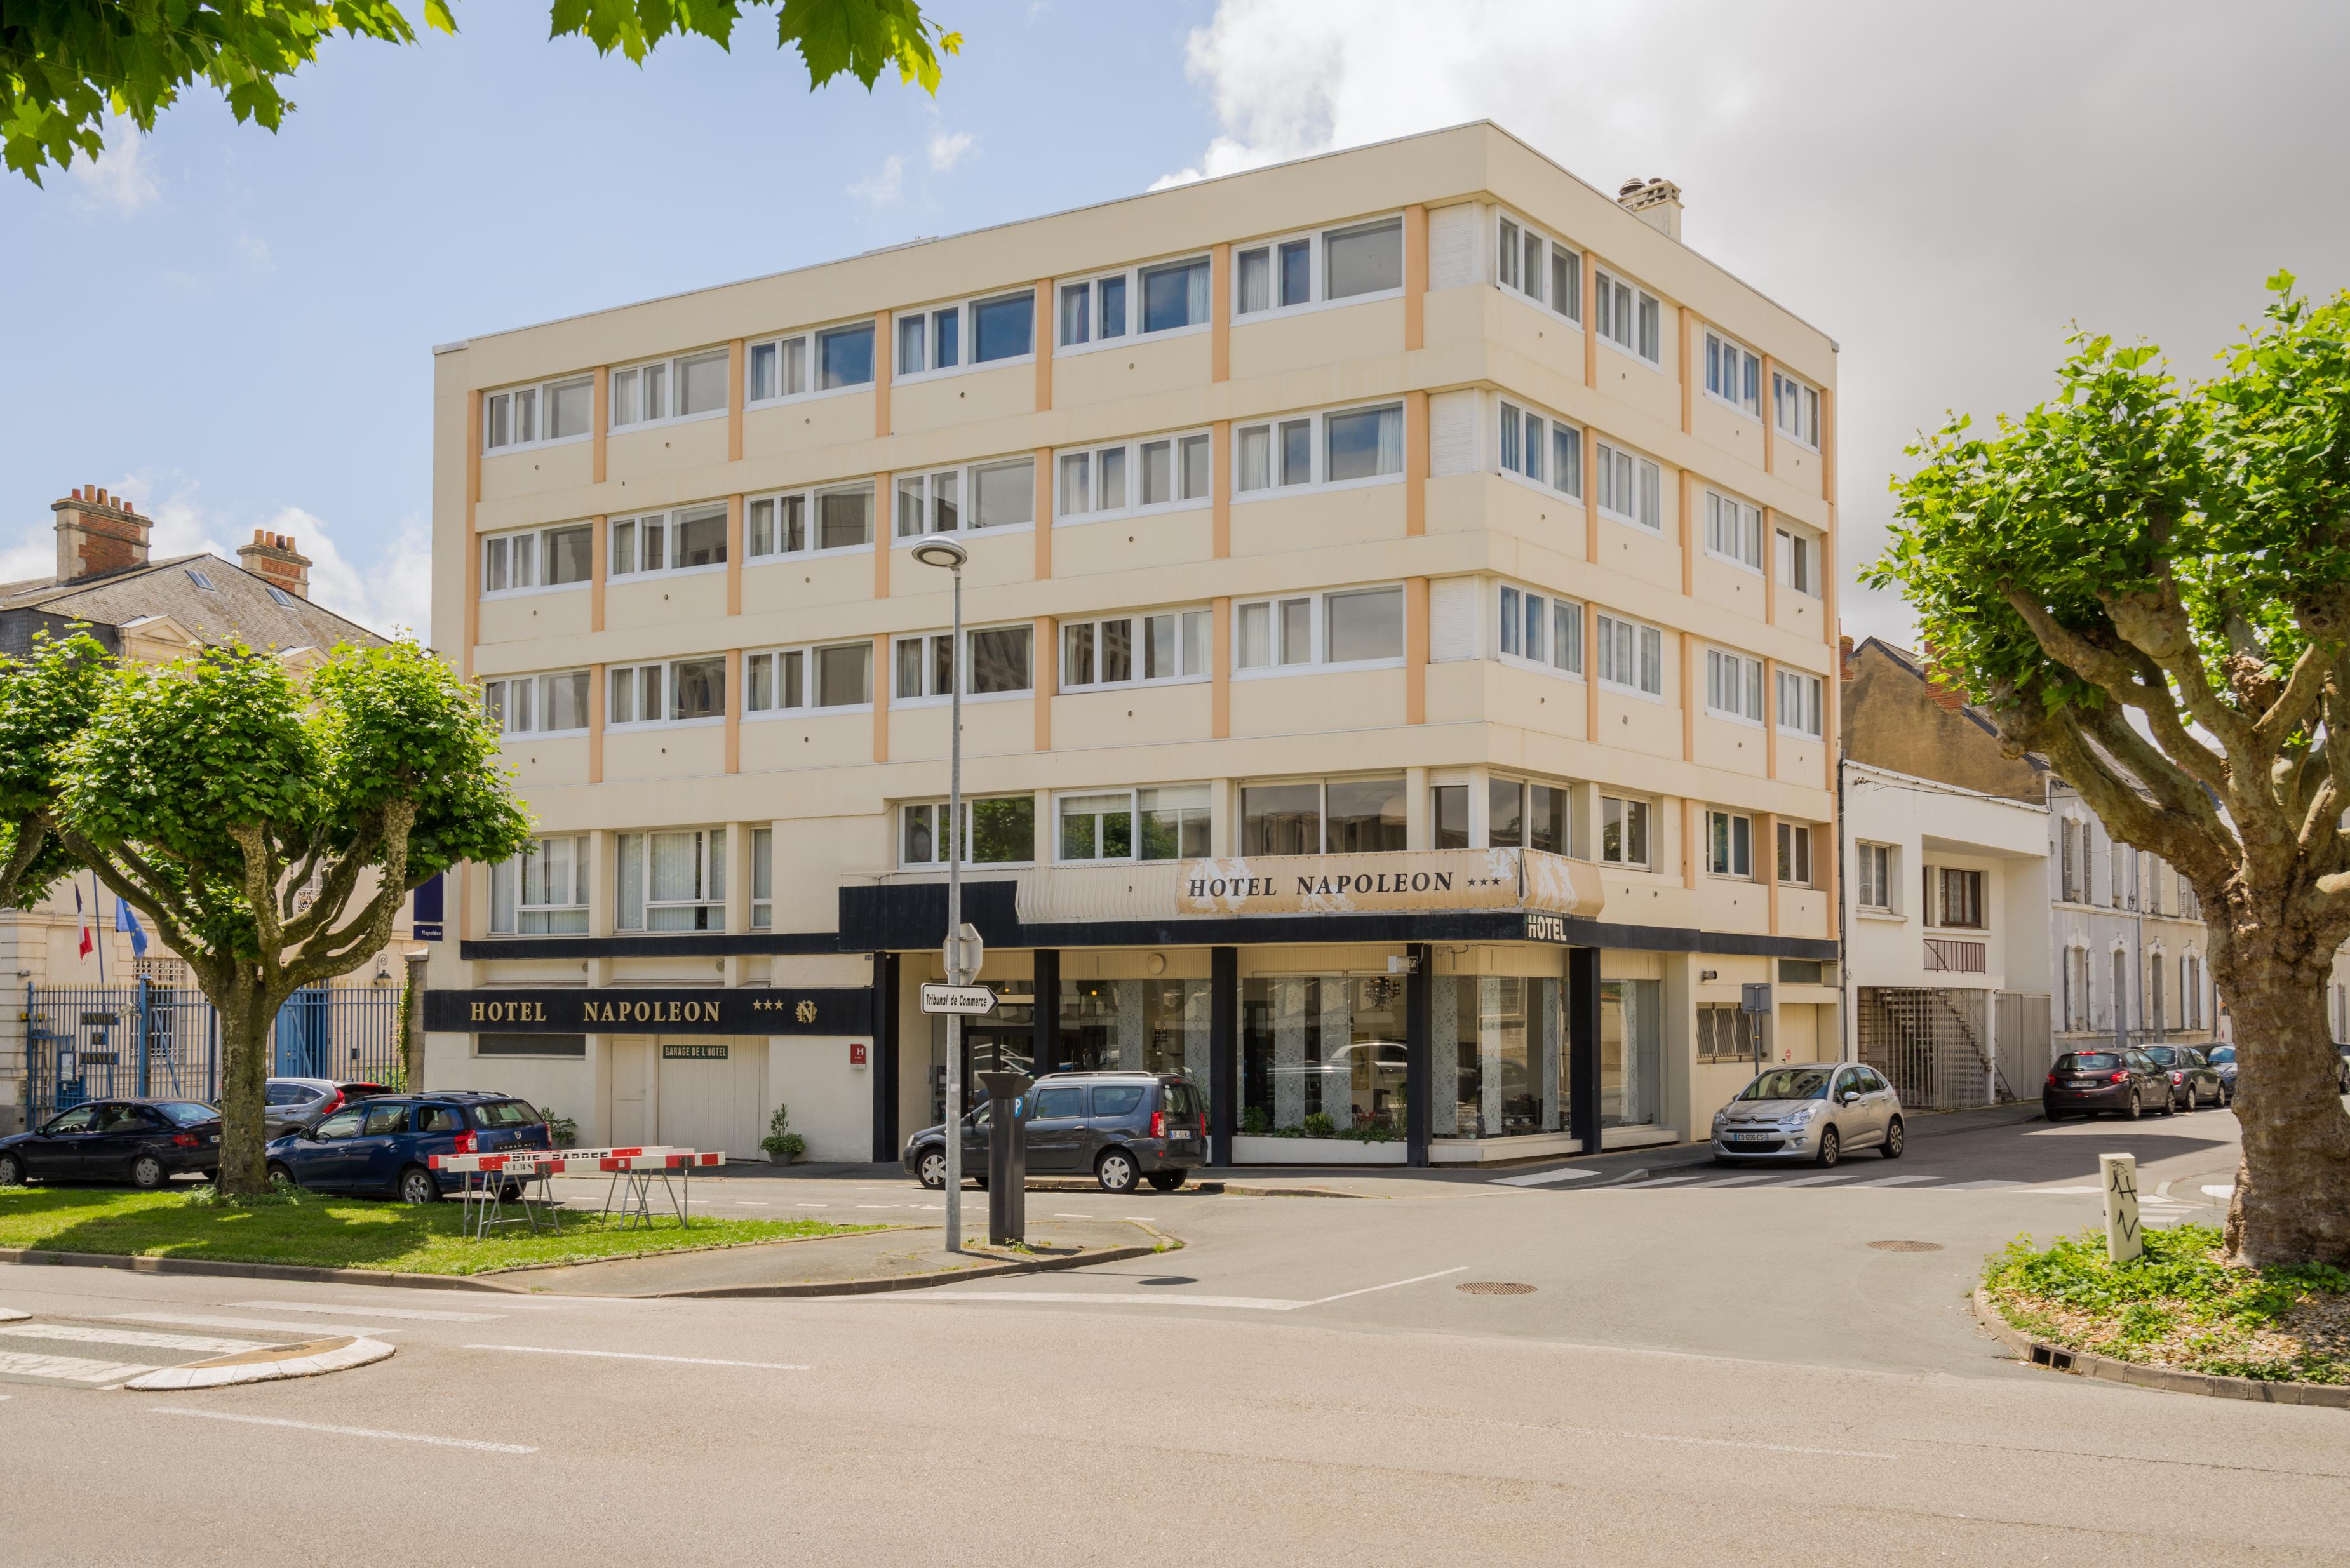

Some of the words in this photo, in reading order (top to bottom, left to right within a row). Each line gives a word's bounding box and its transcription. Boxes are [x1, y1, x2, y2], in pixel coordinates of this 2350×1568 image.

[1188, 877, 1277, 897] HOTEL
[1296, 871, 1454, 895] NAPOLEON
[1528, 914, 1567, 941] HOTEL
[926, 994, 948, 1005] Tribunal
[950, 995, 957, 1006] de
[959, 995, 987, 1007] Commerce
[470, 1002, 547, 1021] HOTEL
[583, 1002, 721, 1022] NAPOLEON
[93, 1033, 102, 1043] DE
[665, 1047, 690, 1056] GARAGE
[692, 1047, 700, 1056] DE
[702, 1047, 727, 1057] L'HOTEL
[857, 1047, 864, 1055] H
[81, 1052, 115, 1064] FRANCE
[1015, 1098, 1021, 1114] P
